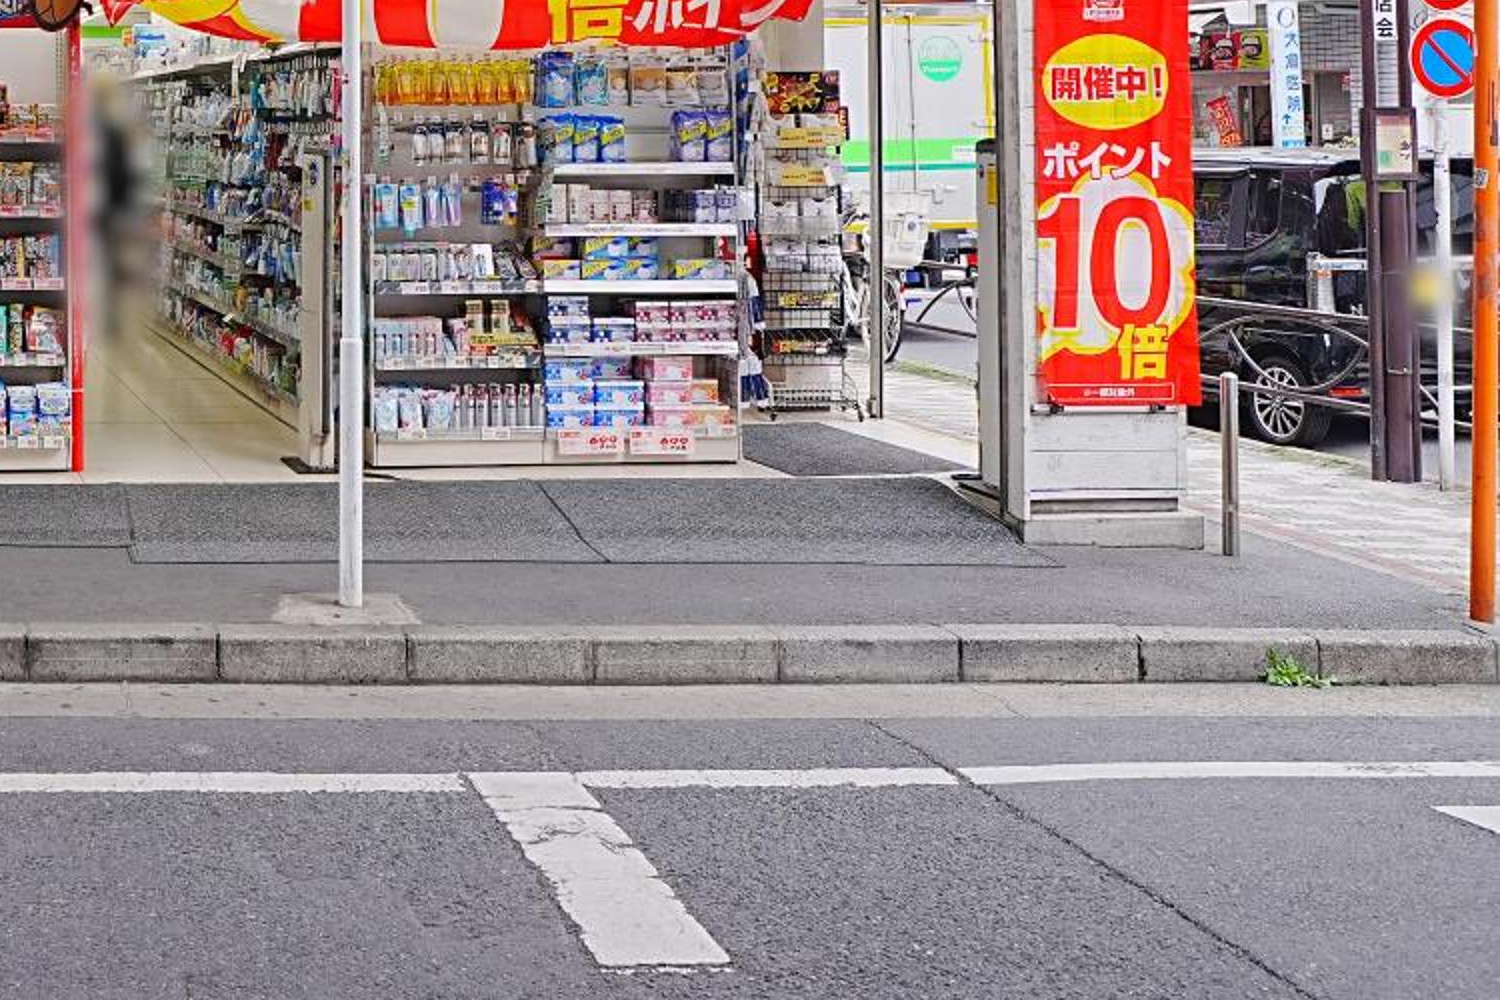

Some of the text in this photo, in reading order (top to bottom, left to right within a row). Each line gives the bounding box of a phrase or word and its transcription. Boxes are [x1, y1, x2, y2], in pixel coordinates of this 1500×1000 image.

[1051, 67, 1163, 101] 開催中!
[1043, 141, 1172, 180] ポイント
[1037, 196, 1172, 331] 10
[1117, 322, 1170, 380] 倍
